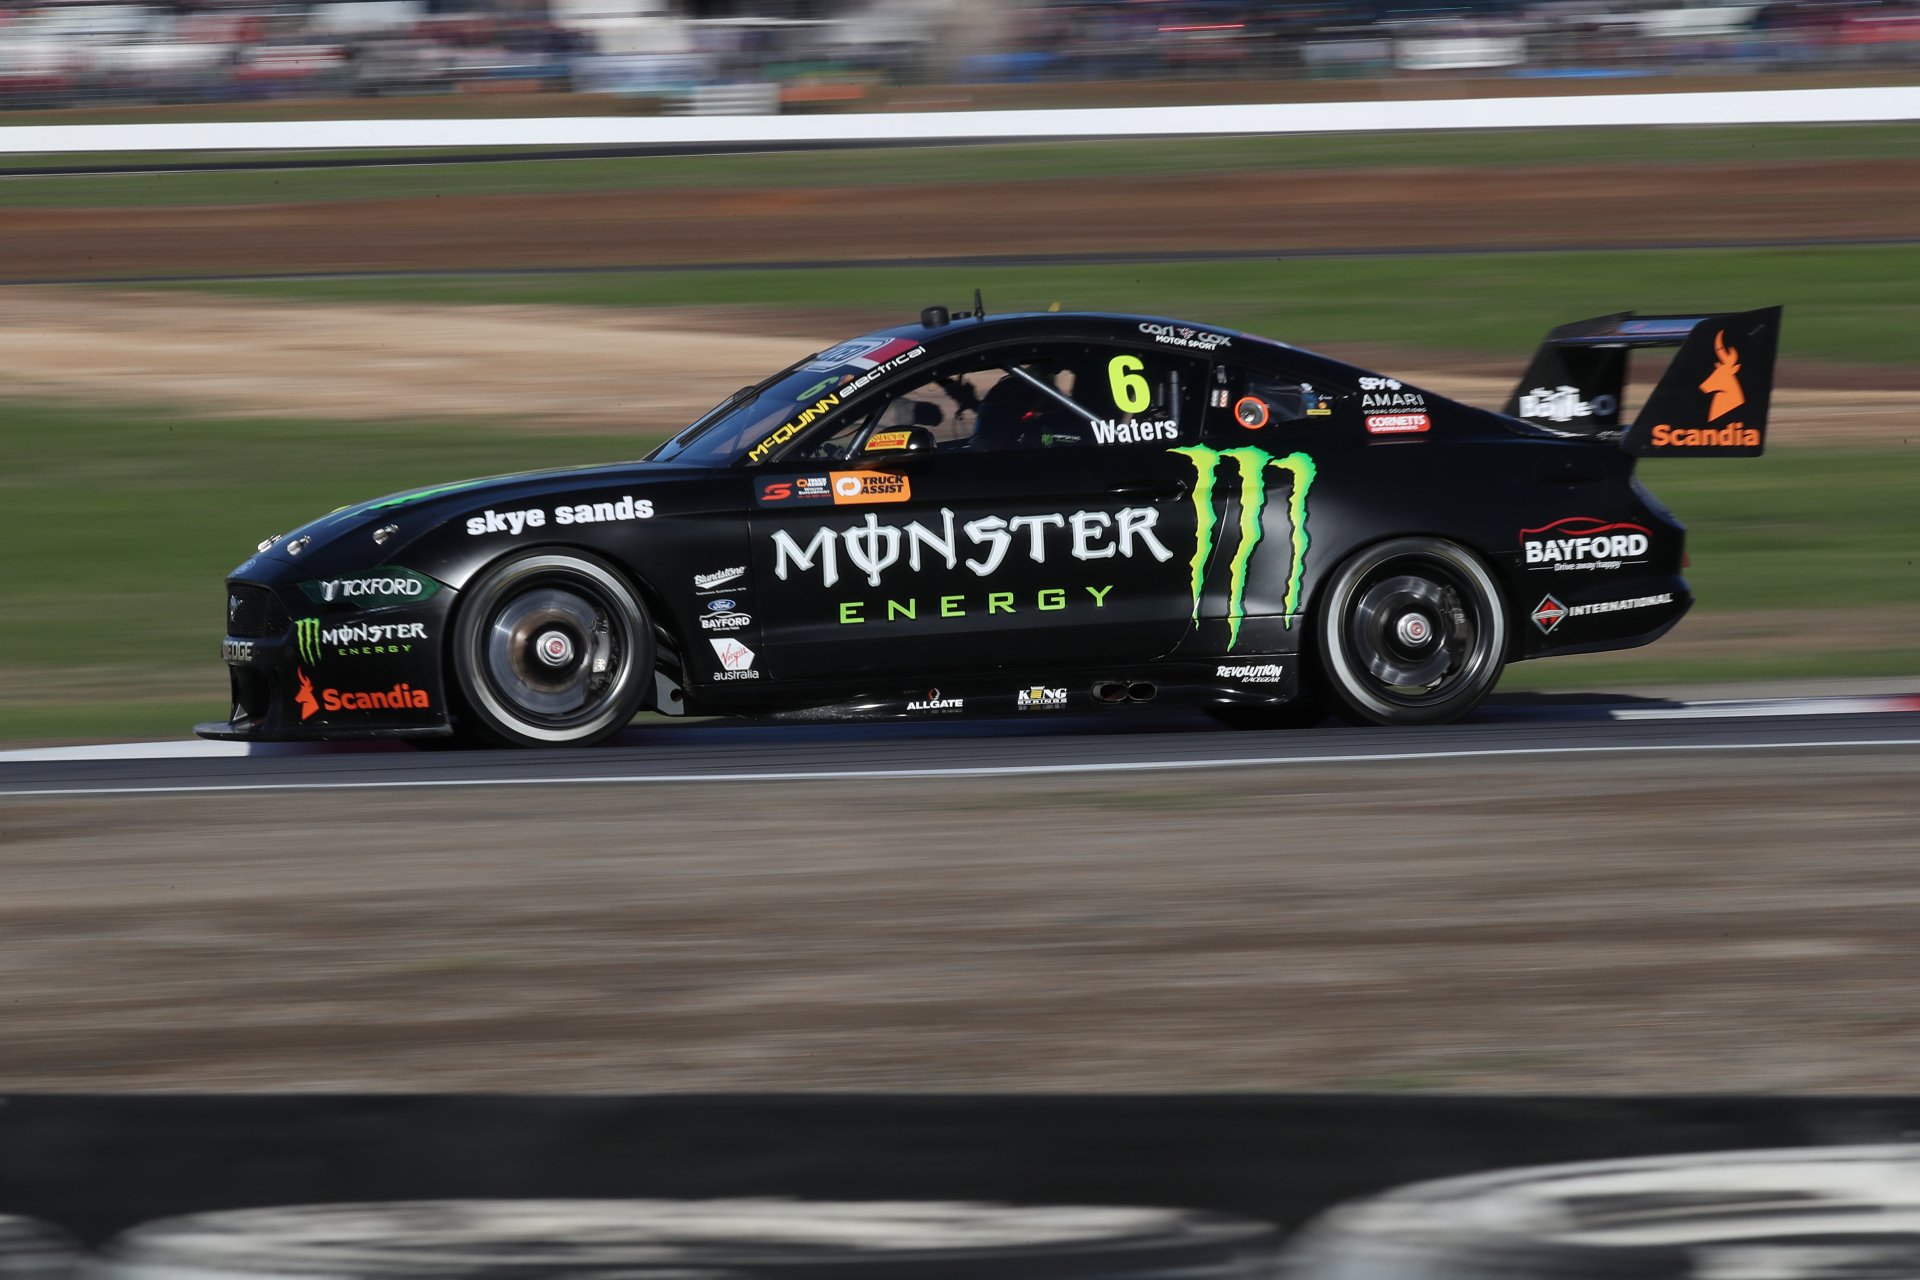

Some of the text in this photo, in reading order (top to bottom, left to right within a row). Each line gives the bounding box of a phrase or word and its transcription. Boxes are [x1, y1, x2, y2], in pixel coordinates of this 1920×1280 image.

[1155, 334, 1217, 351] MOTOR SPORT
[1198, 332, 1232, 346] cox
[839, 345, 926, 398] electrical
[1108, 355, 1151, 414] 6
[1361, 393, 1425, 408] AMARI
[1090, 419, 1179, 445] Waters
[1651, 422, 1761, 446] Scandia
[860, 485, 904, 494] ASSIST
[861, 475, 904, 485] TRUCK
[466, 495, 655, 536] skye sands
[771, 507, 1174, 588] MONSTER
[1524, 533, 1649, 564] BAYFORD
[839, 585, 1114, 624] ENERGY
[1569, 592, 1674, 617] INTERNATIONAL
[322, 622, 428, 646] MONSTER
[701, 616, 751, 629] BAYFORD
[338, 644, 412, 656] ENERGY
[721, 643, 748, 668] Virgin
[713, 669, 759, 681] australia
[1216, 664, 1284, 678] REVOLUTION
[322, 682, 430, 711] Scandia
[906, 699, 964, 711] ALLGATE
